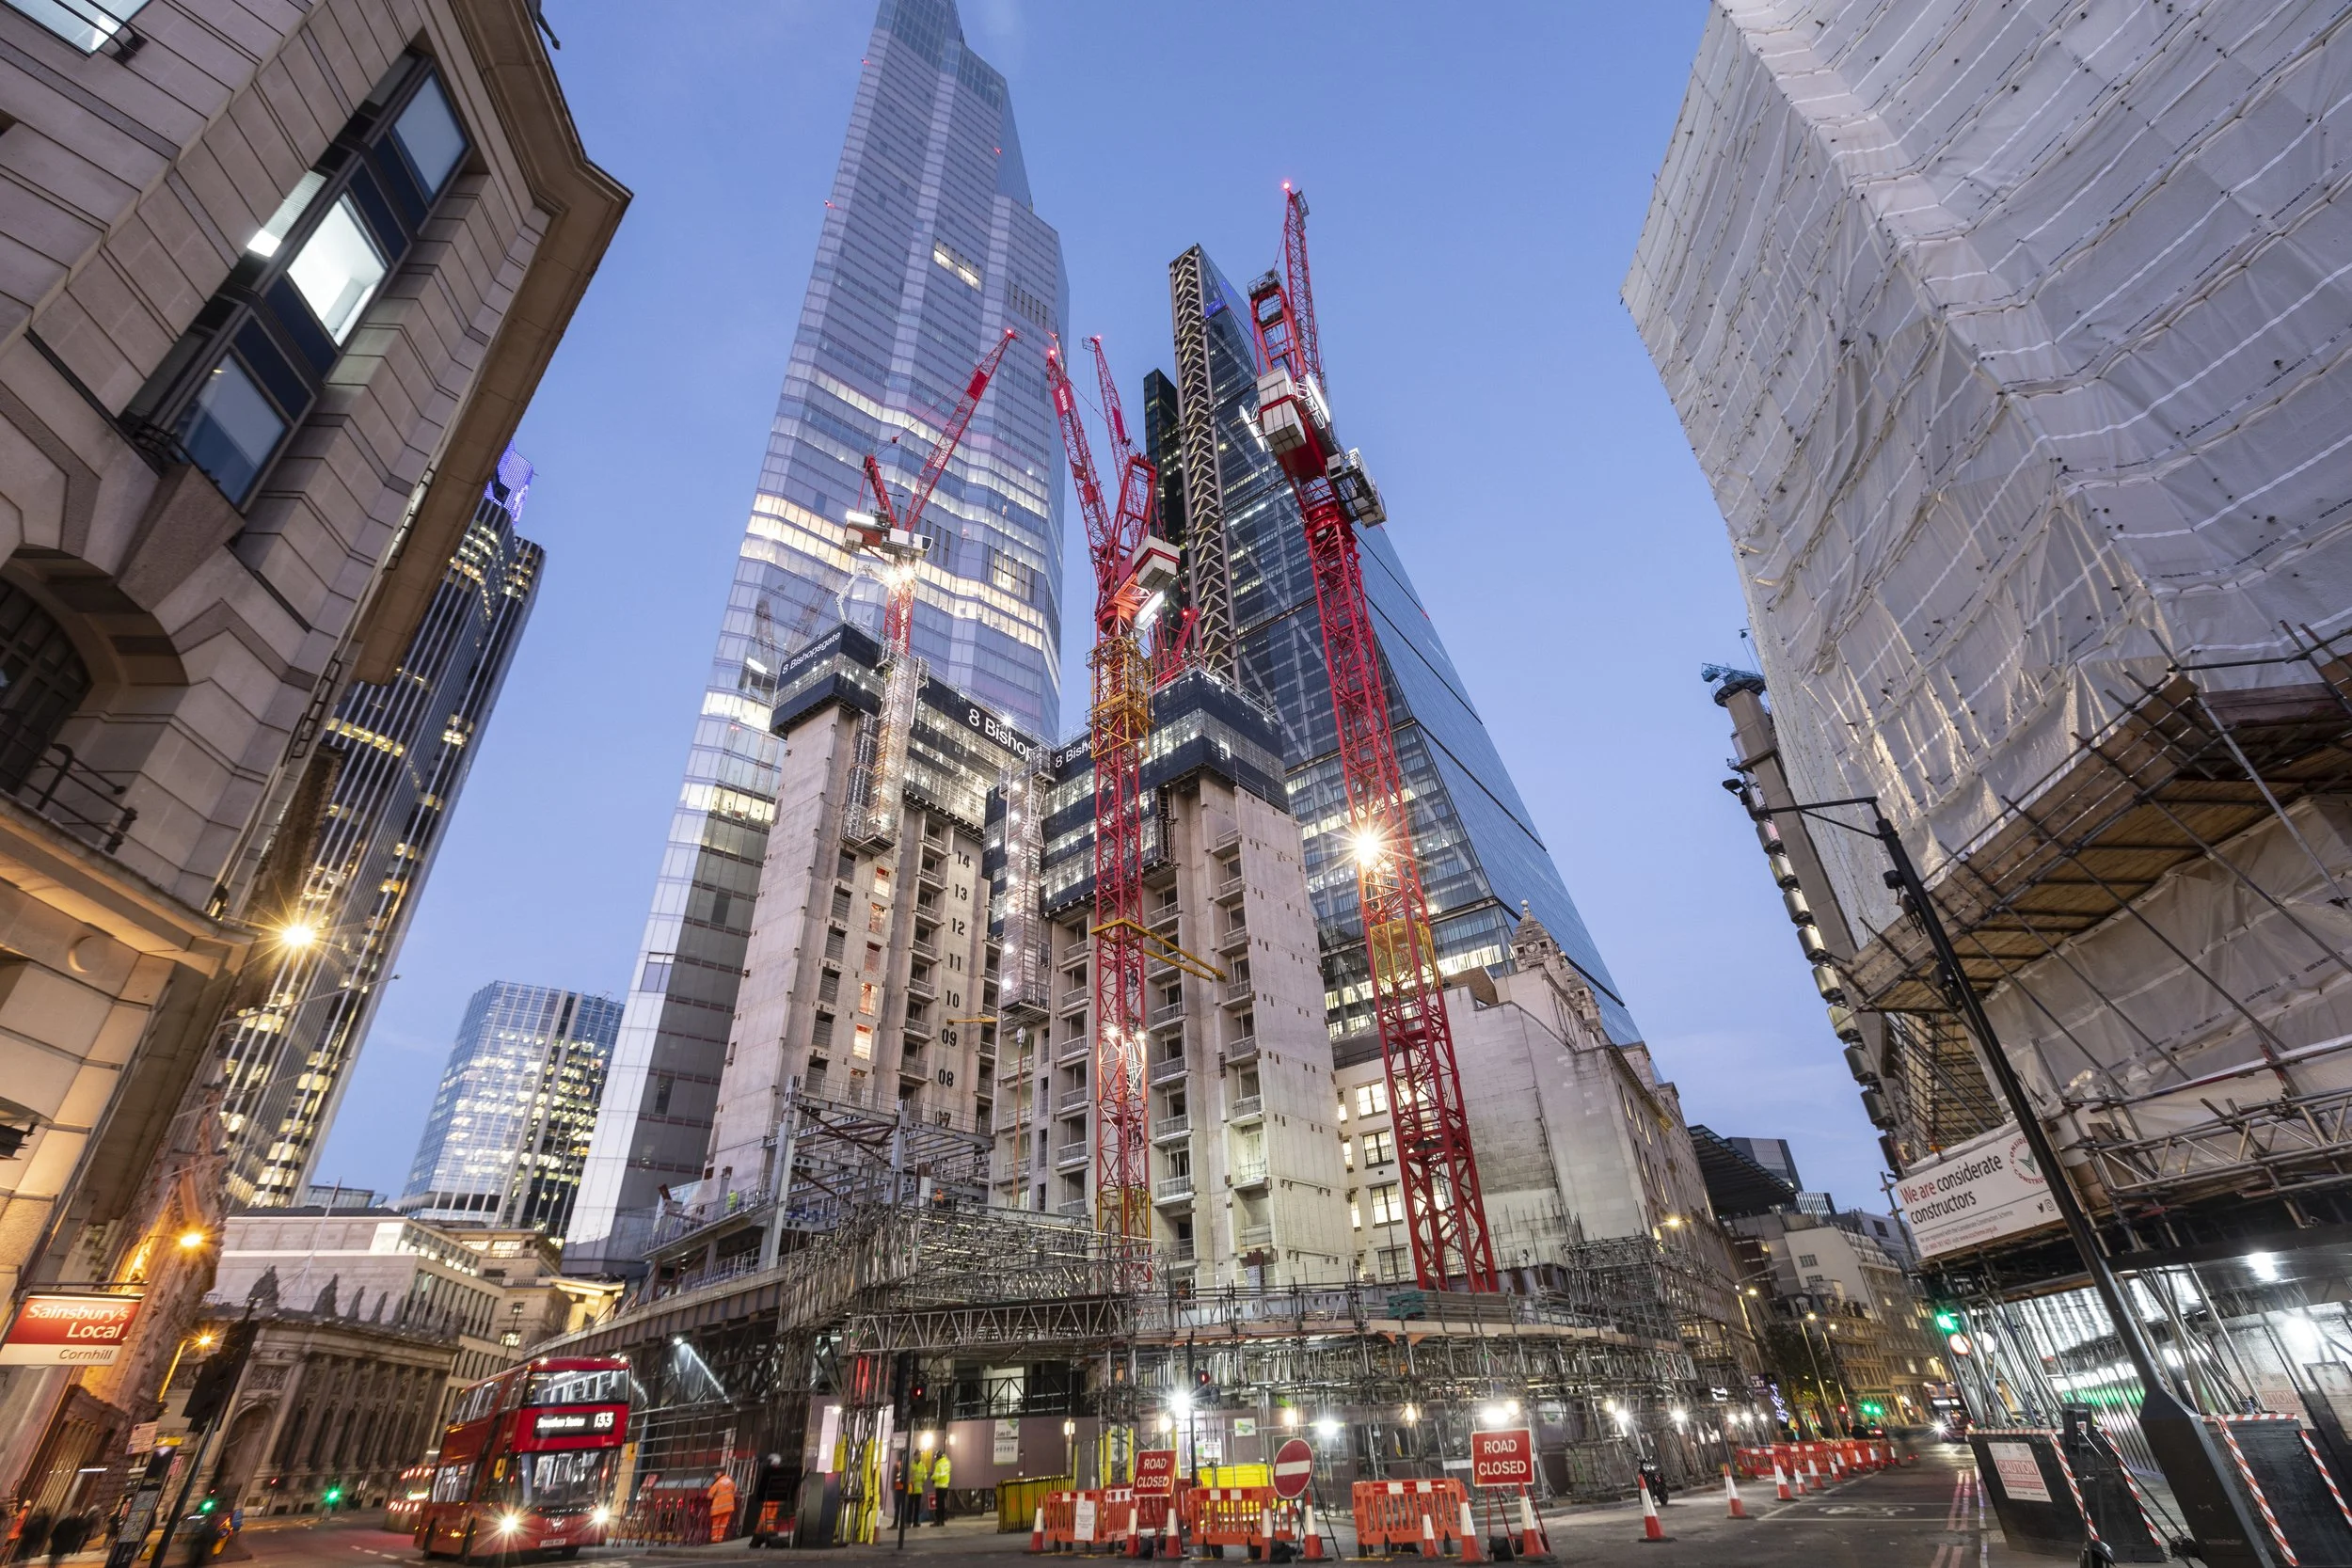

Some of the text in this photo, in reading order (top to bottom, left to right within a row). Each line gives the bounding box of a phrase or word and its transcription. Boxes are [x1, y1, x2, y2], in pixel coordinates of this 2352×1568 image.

[782, 632, 841, 674] 8 Bishopsgate
[968, 708, 980, 727] 8
[1055, 754, 1063, 768] 8
[958, 850, 970, 868] 14
[955, 883, 967, 901] 13
[952, 917, 965, 936] 12
[949, 953, 961, 972] 11
[946, 990, 960, 1008] 10
[942, 1028, 958, 1047] 09
[938, 1069, 954, 1087] 08
[1899, 1155, 2004, 1205] We are considerate
[1911, 1191, 1977, 1225] constructors
[26, 1304, 131, 1323] Sainsbury's
[66, 1322, 124, 1339] Local
[58, 1349, 114, 1360] Cornhill
[594, 1412, 614, 1428] 133
[1484, 1439, 1518, 1454] ROAD
[1144, 1458, 1167, 1470] ROAD
[1478, 1460, 1527, 1476] CLOSED
[1998, 1460, 2037, 1475] CAUTION
[1136, 1476, 1169, 1488] CLOSED
